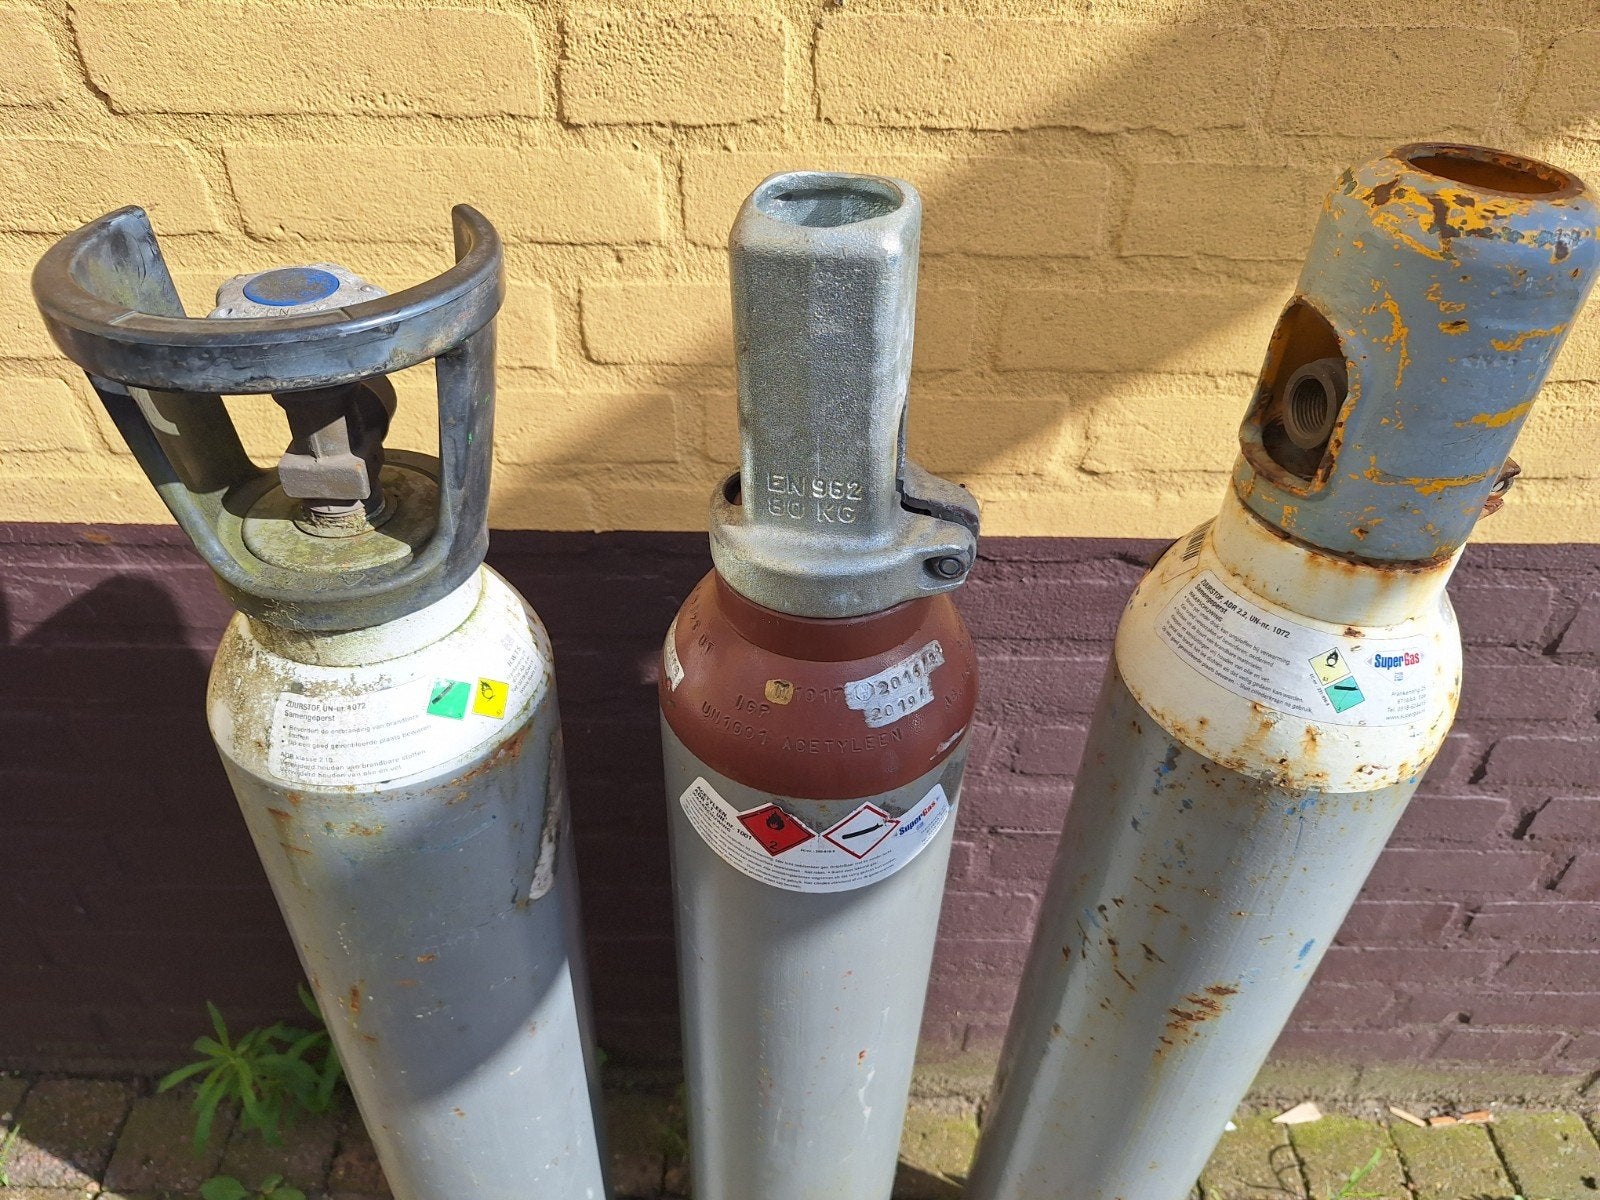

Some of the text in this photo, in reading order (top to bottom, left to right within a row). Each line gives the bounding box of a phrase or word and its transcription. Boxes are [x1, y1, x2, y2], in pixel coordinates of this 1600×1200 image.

[767, 472, 862, 500] EN 962
[817, 501, 857, 524] KG
[1223, 600, 1238, 611] ADR
[1249, 614, 1270, 631] UN-nr.
[1272, 626, 1291, 639] 1072
[1374, 652, 1420, 669] SuperGas
[284, 709, 335, 722] Samengeperst
[782, 728, 903, 754] ACETYLEEN
[899, 800, 937, 836] SuperGas
[737, 828, 752, 840] 1001
[769, 841, 778, 849] 2
